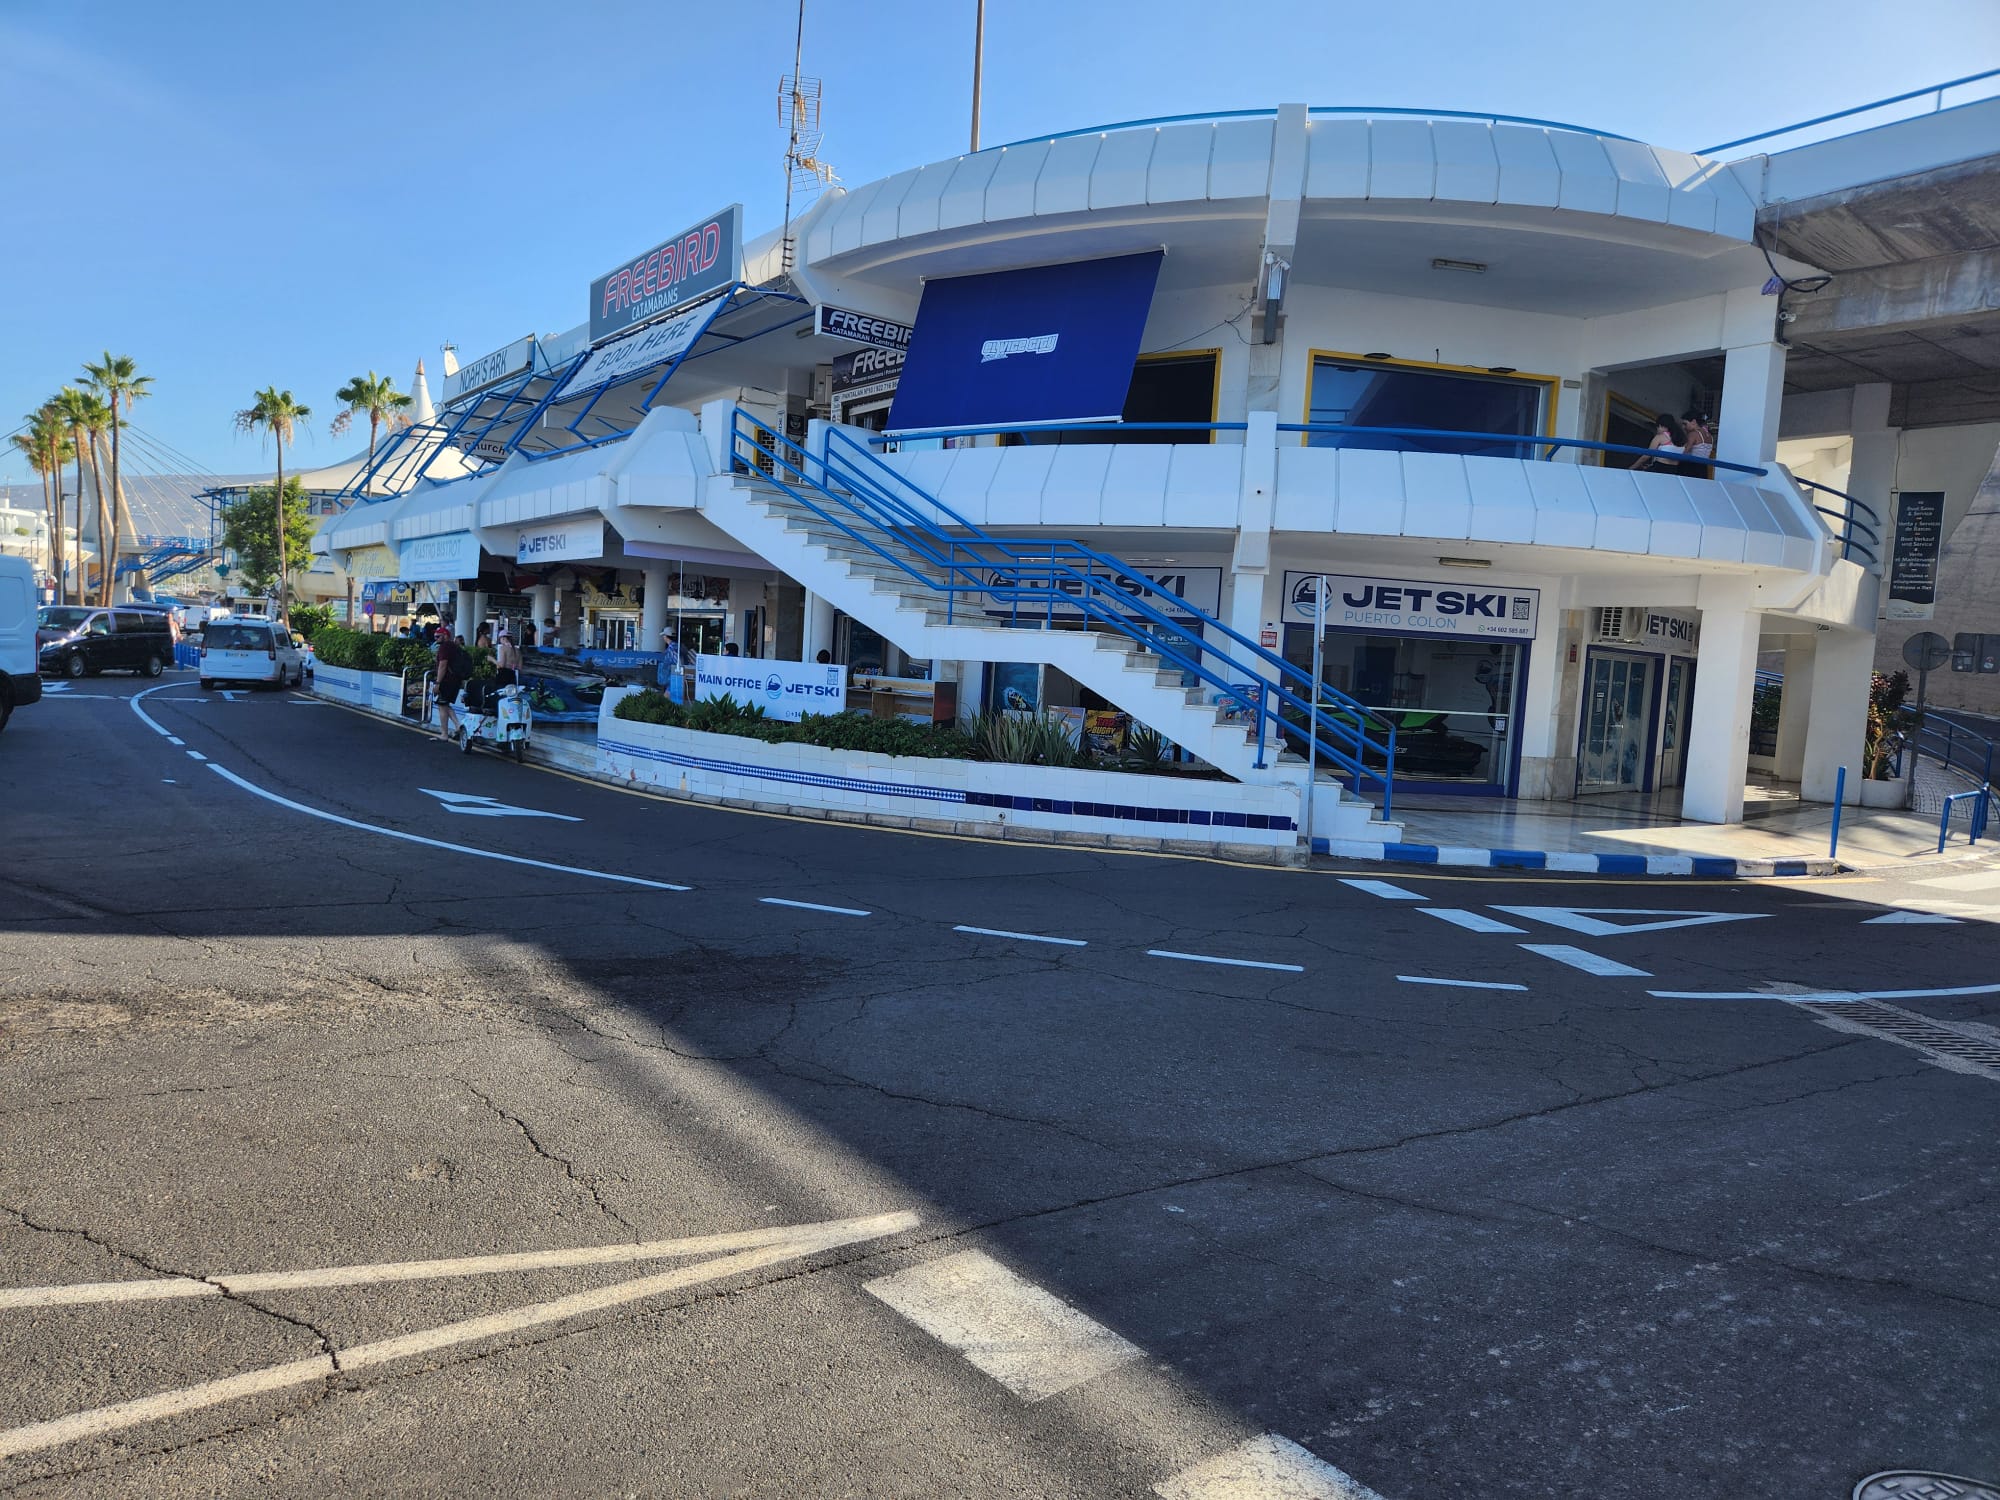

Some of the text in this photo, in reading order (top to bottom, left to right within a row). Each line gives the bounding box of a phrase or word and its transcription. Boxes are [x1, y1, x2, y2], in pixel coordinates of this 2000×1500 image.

[602, 222, 720, 319] FREEBIRD
[631, 287, 678, 320] CATAMARANS
[639, 315, 698, 352] HERE
[831, 326, 870, 341] CATAMARAN
[874, 337, 895, 347] Central
[459, 349, 508, 393] NOAH'S ARK
[395, 594, 408, 602] ATM
[1344, 610, 1457, 629] PUERTO COLON
[698, 673, 761, 690] MAIN OFFICE
